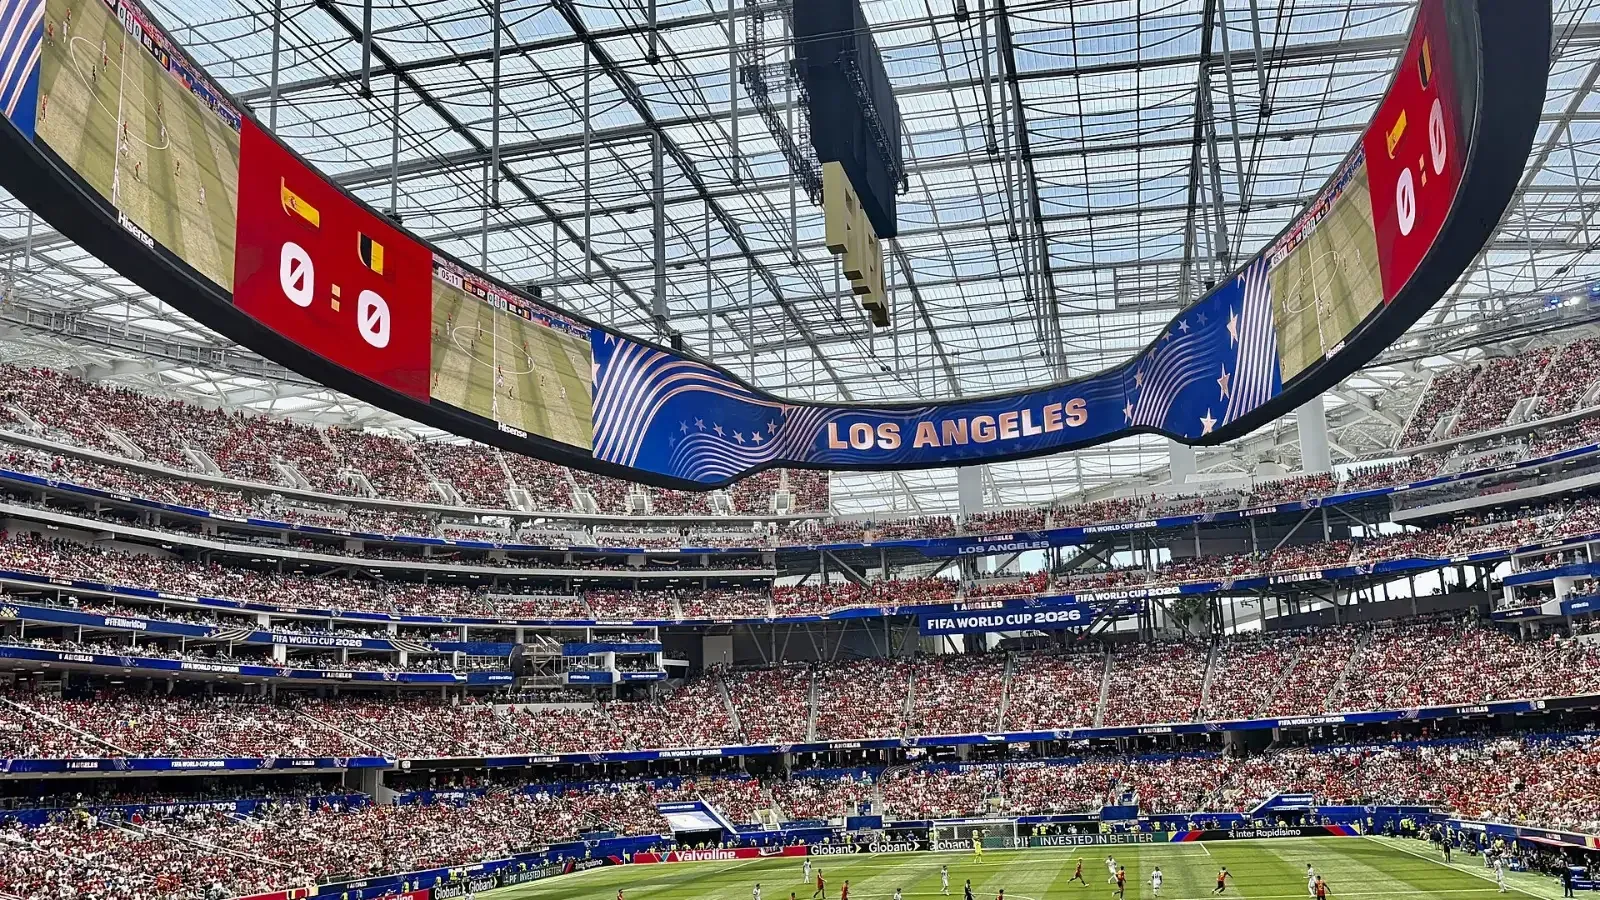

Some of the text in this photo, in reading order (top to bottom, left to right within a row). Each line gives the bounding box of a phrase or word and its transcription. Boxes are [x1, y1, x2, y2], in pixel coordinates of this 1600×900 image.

[1396, 167, 1416, 236] 0
[1428, 98, 1447, 176] 0
[118, 210, 154, 249] Hisense
[441, 269, 459, 286] 05:11
[280, 242, 314, 308] 0
[357, 289, 391, 349] 0
[498, 422, 528, 439] Hisense
[828, 398, 1088, 450] LOS ANGELES
[1082, 520, 1158, 534] FIFA WORLD CUP 2026
[958, 540, 1050, 554] LOS ANGELES
[1278, 571, 1322, 584] ANGELES
[1075, 586, 1182, 603] FIFA WORLD CUP 2026
[961, 600, 1003, 610] ANGELES
[104, 618, 147, 630] #FIFAWorldCup
[928, 610, 1081, 630] FIFA WORLD CUP 2026
[272, 634, 362, 648] FIFA WORLD CUP 2026
[959, 764, 974, 772] FIFA
[1003, 762, 1018, 770] CUP
[1040, 832, 1154, 846] INVESTED IN BETTER
[1236, 830, 1254, 838] Inter
[811, 844, 854, 856] Globant
[868, 841, 912, 854] Globant
[520, 866, 562, 882] INVESTED IN BETTER
[434, 884, 462, 900] Globant
[468, 878, 494, 894] Globant
